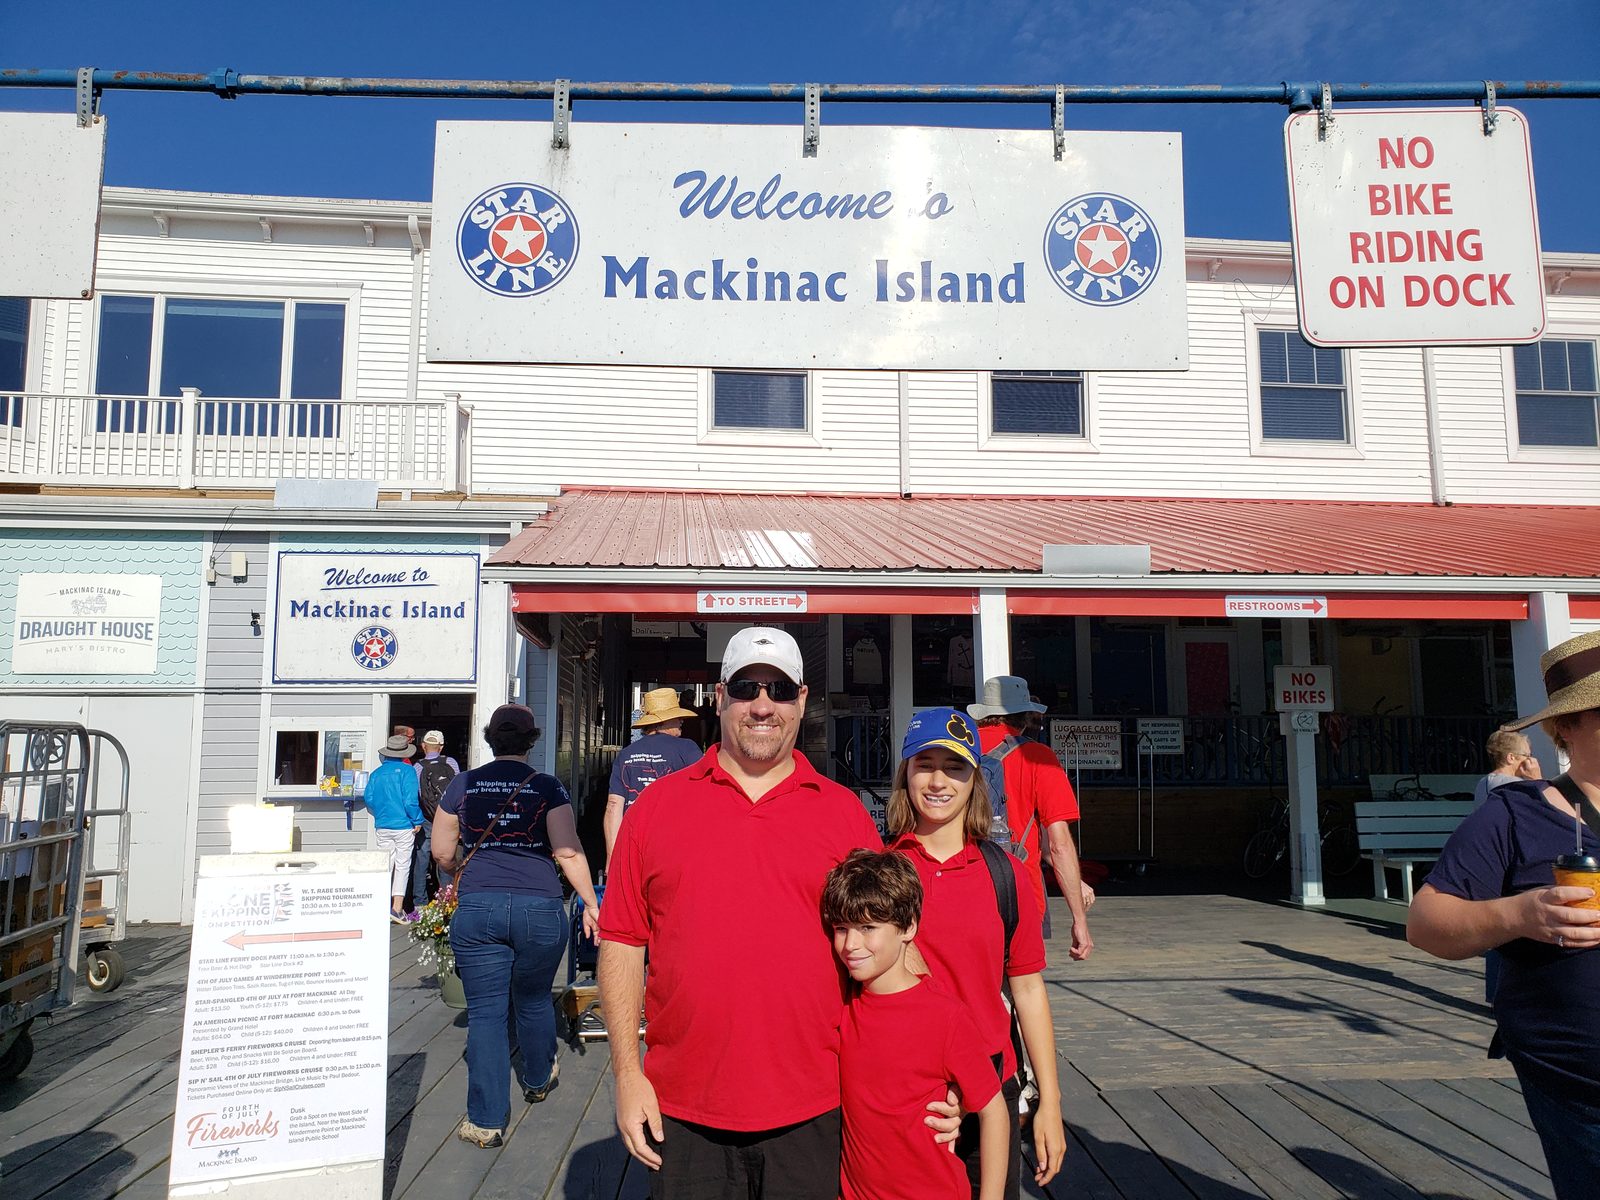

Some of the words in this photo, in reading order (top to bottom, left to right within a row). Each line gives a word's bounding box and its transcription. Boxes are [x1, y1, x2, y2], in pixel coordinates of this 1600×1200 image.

[1378, 136, 1434, 169] NO
[673, 169, 894, 221] Welcome
[1368, 183, 1453, 215] BIKE
[471, 190, 566, 233] STAR
[1055, 200, 1147, 242] STAR
[1350, 228, 1483, 264] RIDING
[467, 248, 566, 291] LINE
[601, 255, 847, 302] Mackinac
[875, 259, 1026, 303] Island
[1056, 259, 1151, 301] LINE
[1329, 275, 1385, 309] ON
[1403, 273, 1515, 307] DOCK
[324, 567, 407, 586] Welcome
[412, 567, 430, 581] to
[59, 586, 94, 596] MACKINAC
[96, 587, 121, 596] ISLAND
[290, 600, 392, 618] Mackinac
[402, 601, 466, 619] Island
[717, 597, 735, 606] TO
[738, 597, 786, 606] STREET
[1229, 601, 1301, 611] RESTROOMS
[19, 621, 97, 641] DRAUGHT
[101, 622, 154, 641] HOUSE
[357, 629, 393, 645] STAR
[46, 645, 85, 654] MARY'S
[89, 645, 126, 654] BISTRO
[355, 651, 394, 668] LINE
[1291, 672, 1316, 686] NO
[1282, 690, 1326, 704] BIKES
[207, 919, 270, 928] OMPETITION
[195, 997, 244, 1005] STAR-SPANGLED
[190, 1047, 225, 1055] SHEPLER'S
[247, 1042, 283, 1050] FIREWORKS
[263, 1069, 299, 1077] FIREWORKS
[206, 1091, 235, 1099] Purchased
[223, 1104, 260, 1113] FOURTH
[237, 1110, 259, 1119] JULY
[186, 1110, 280, 1146] Fireworks
[289, 1128, 320, 1136] Windermere
